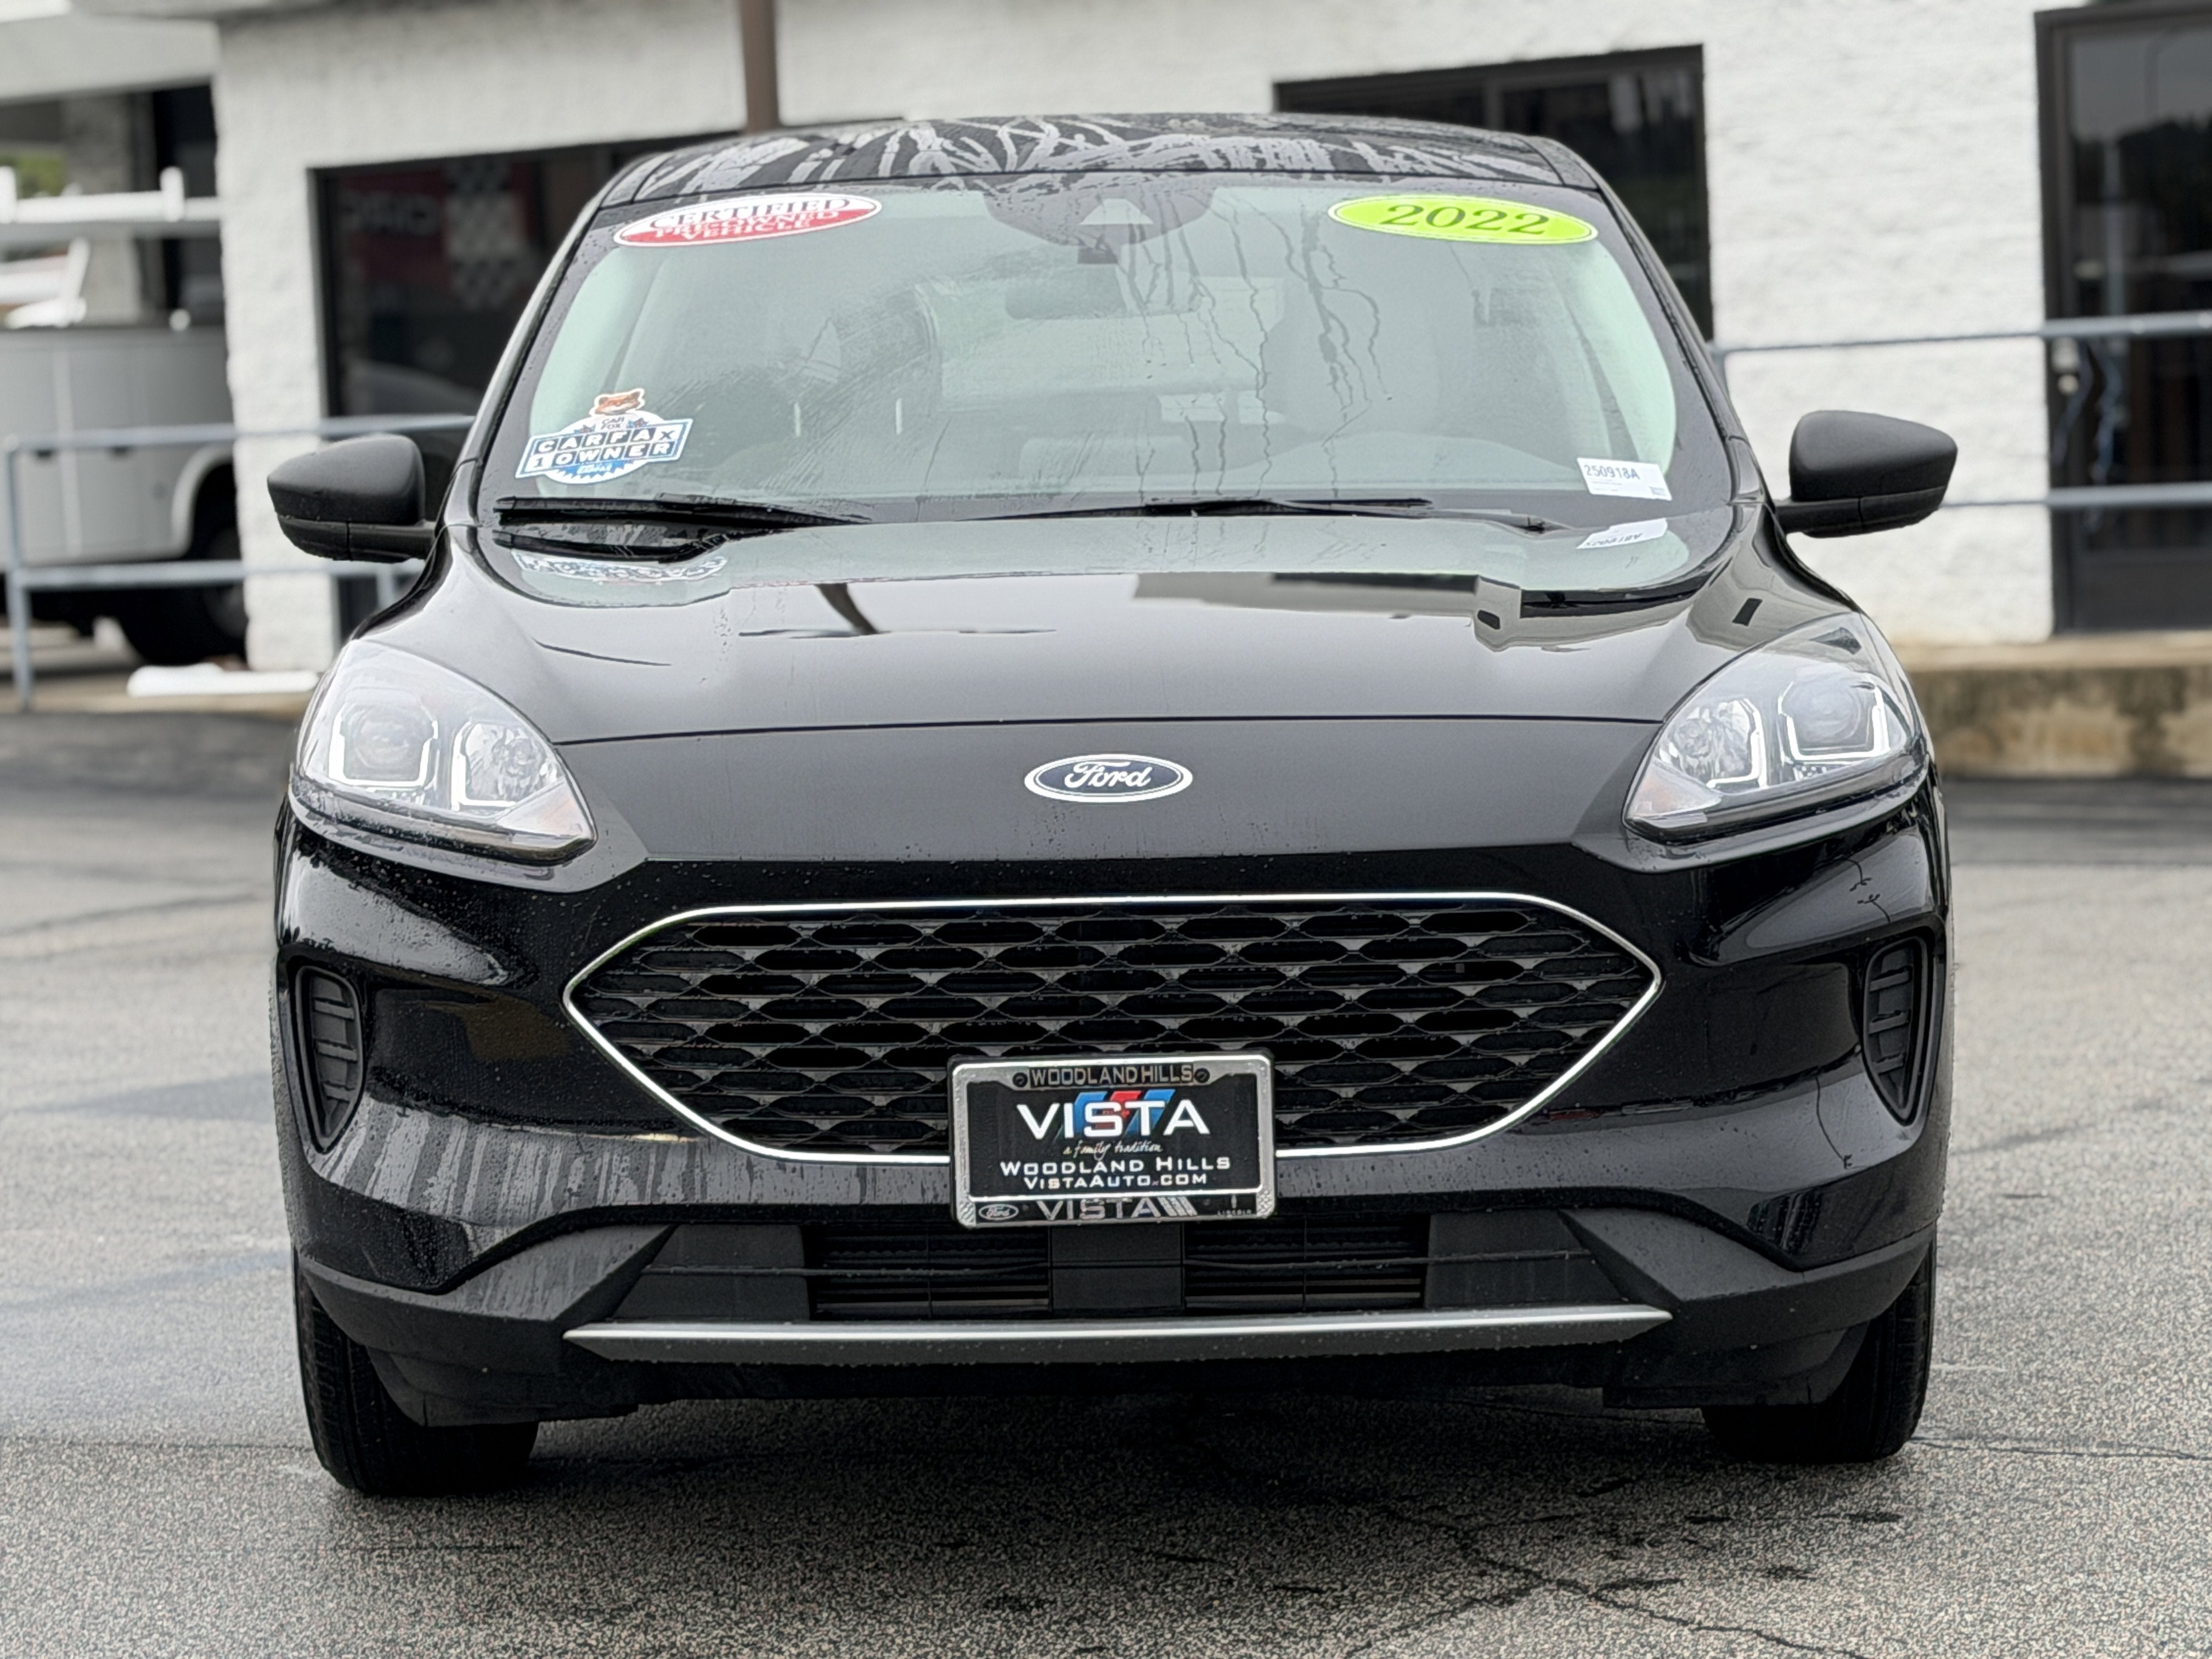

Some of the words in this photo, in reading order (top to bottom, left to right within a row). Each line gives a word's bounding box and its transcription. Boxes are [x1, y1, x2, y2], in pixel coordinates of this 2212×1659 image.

[650, 199, 850, 228] CERTIFIED
[1379, 204, 1549, 235] 2022
[682, 221, 811, 240] VEHICLE
[538, 429, 676, 453] CARFAX
[533, 456, 544, 467] 1
[555, 443, 671, 465] OWNER
[1583, 464, 1640, 480] 250918A
[1064, 761, 1152, 788] Ford
[1031, 1066, 1137, 1086] WOODLAND
[1141, 1064, 1193, 1084] HILLS
[1017, 1099, 1210, 1140] VISTA
[1073, 1139, 1111, 1161] family
[1114, 1139, 1164, 1153] tradition
[1000, 1159, 1144, 1176] WOODLAND
[1155, 1156, 1231, 1171] HILLS
[1024, 1173, 1206, 1190] VISTAAUTO.COM
[1036, 1197, 1161, 1221] VISTA
